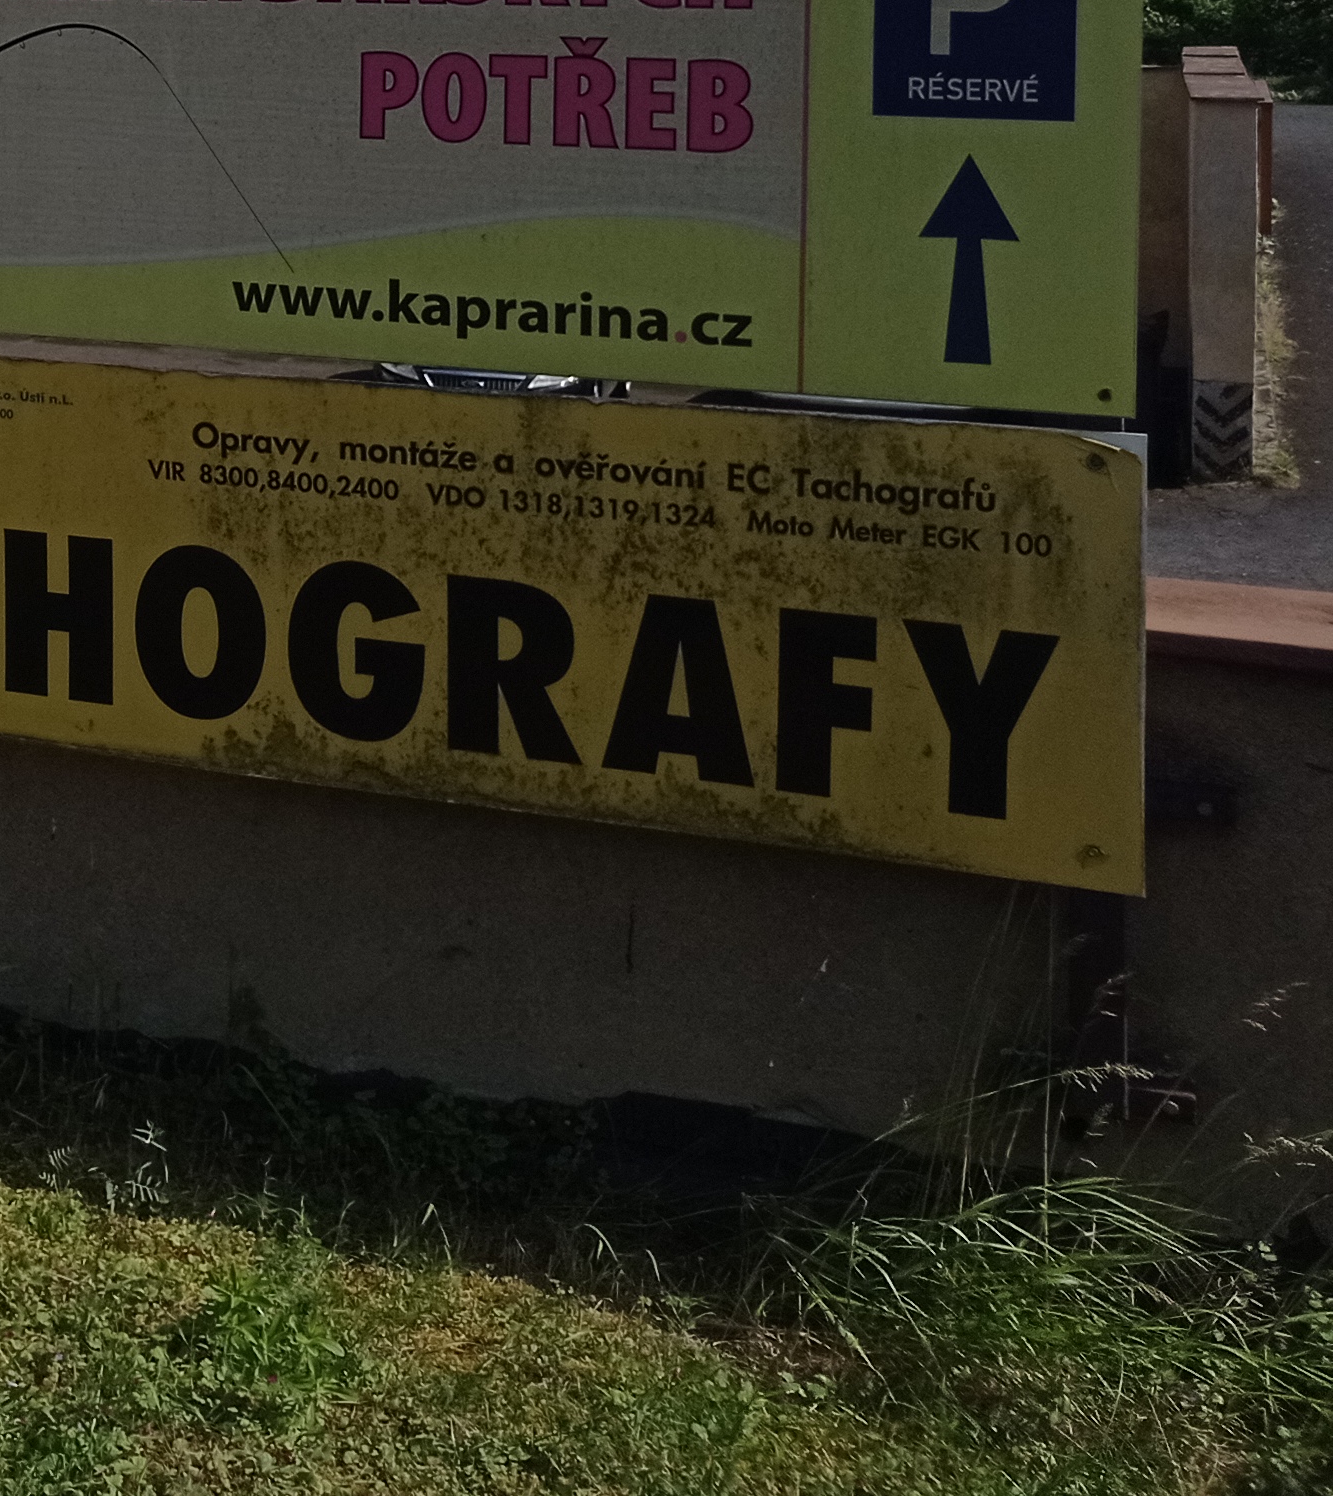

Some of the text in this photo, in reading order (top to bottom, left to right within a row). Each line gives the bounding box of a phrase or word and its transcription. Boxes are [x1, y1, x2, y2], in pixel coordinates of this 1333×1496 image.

[359, 36, 754, 153] POTŘEB
[908, 72, 1038, 102] RÉSERVÉ
[232, 278, 754, 348] www.kaprarina.cz
[147, 459, 1053, 559] VIR 8300,8400,2400 VDO 1318,1319,1324 Moto Meter EGK 100
[192, 421, 997, 514] Opravy, montáže a ověřování EC Tachografů
